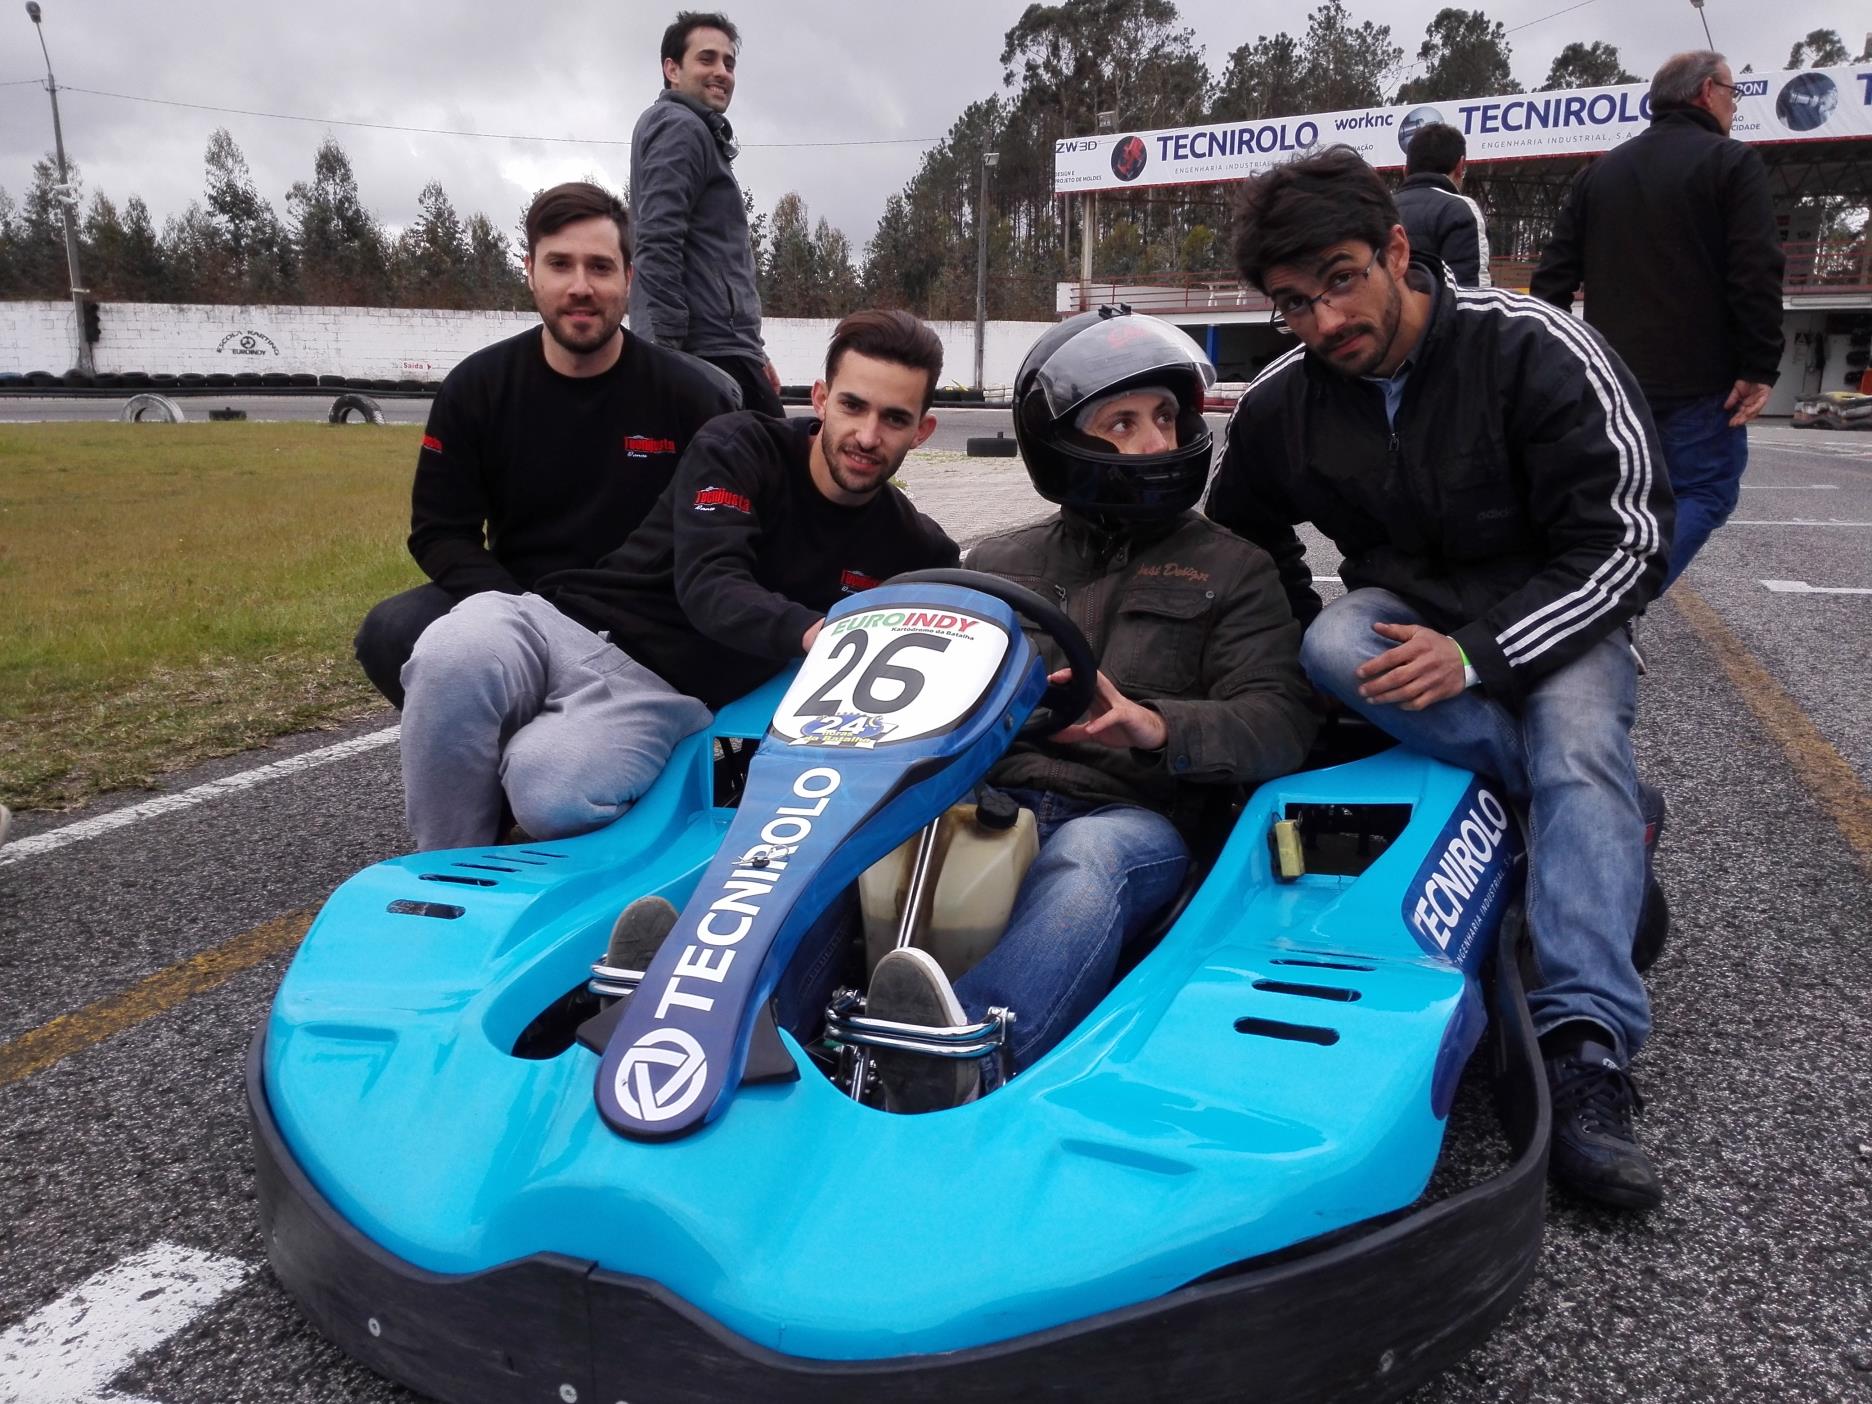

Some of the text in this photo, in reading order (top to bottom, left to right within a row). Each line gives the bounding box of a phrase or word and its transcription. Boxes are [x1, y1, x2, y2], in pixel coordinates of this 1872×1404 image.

[1335, 112, 1393, 131] worknc
[1055, 140, 1098, 154] ZW3D
[1157, 121, 1319, 161] TECNIROLO
[1481, 138, 1543, 149] ENGENHARIA
[1175, 164, 1223, 174] ENGENHARIA
[793, 628, 952, 717] 26
[811, 716, 868, 735] 24
[654, 767, 842, 1019] TECNIROLO
